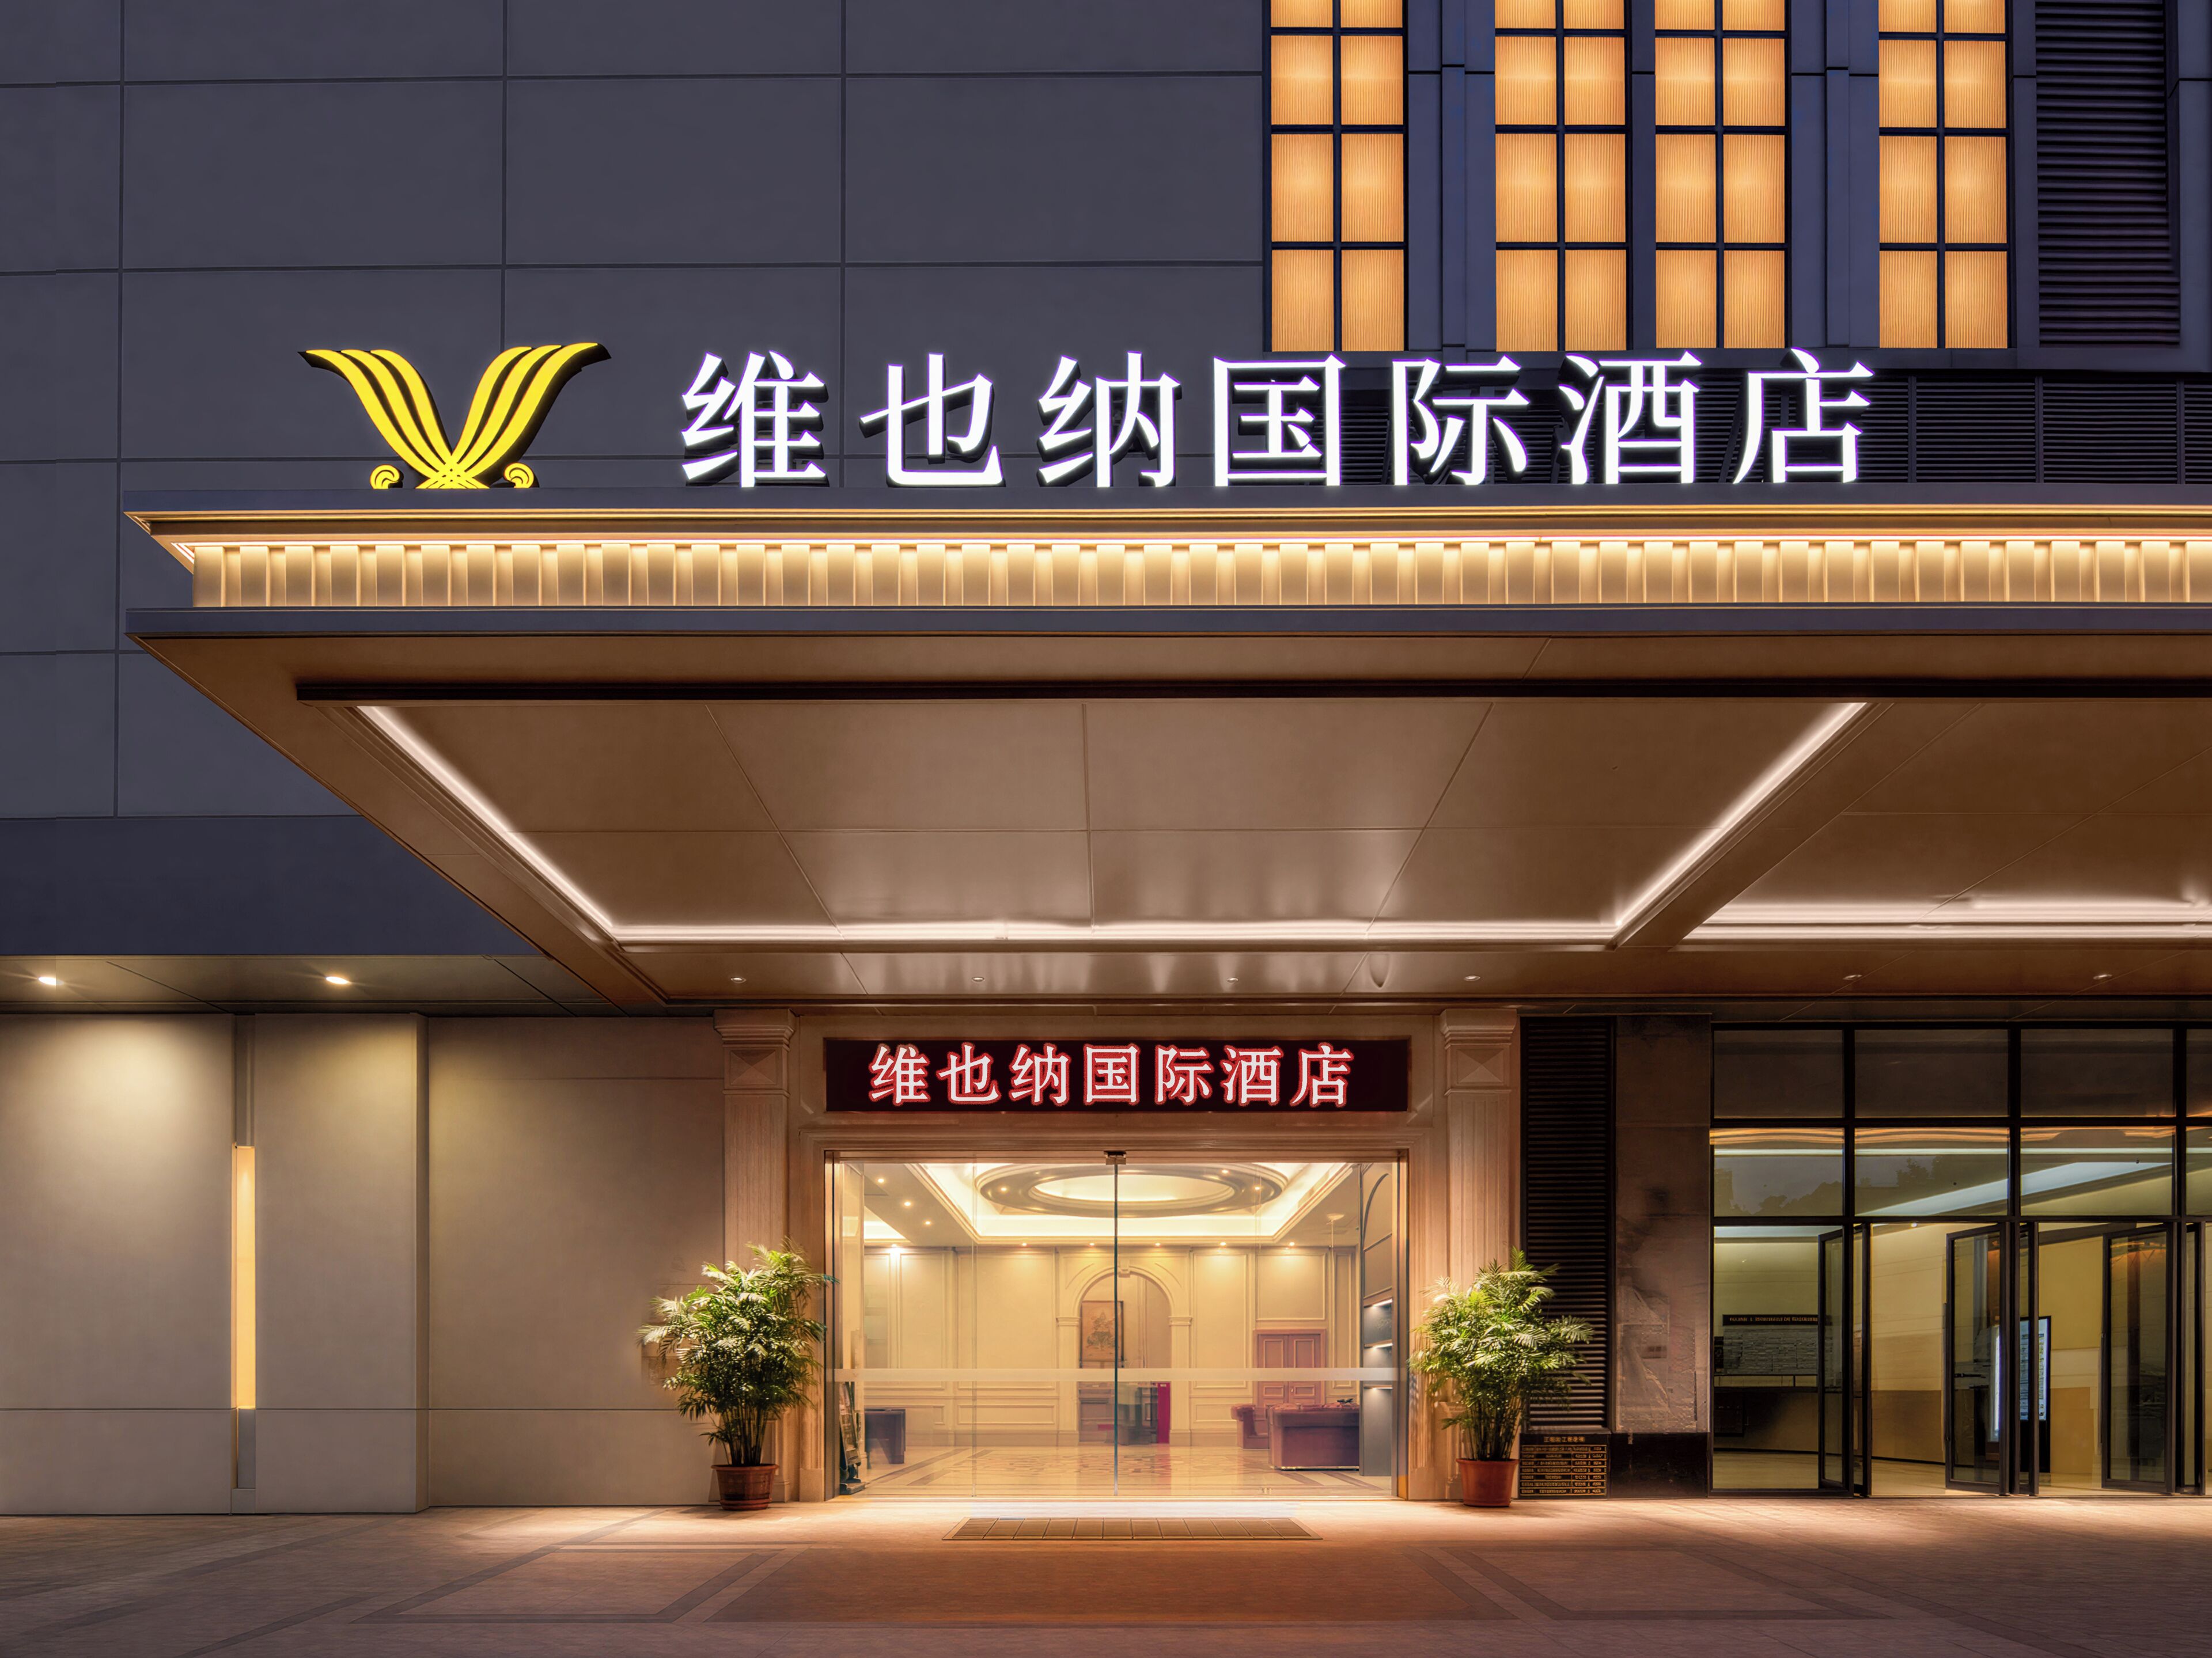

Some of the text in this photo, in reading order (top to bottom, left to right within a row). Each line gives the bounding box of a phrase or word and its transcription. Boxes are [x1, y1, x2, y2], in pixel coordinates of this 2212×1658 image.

[681, 348, 1873, 488] 维也纳国际酒店
[869, 1043, 1353, 1106] 维也纳国际酒店
